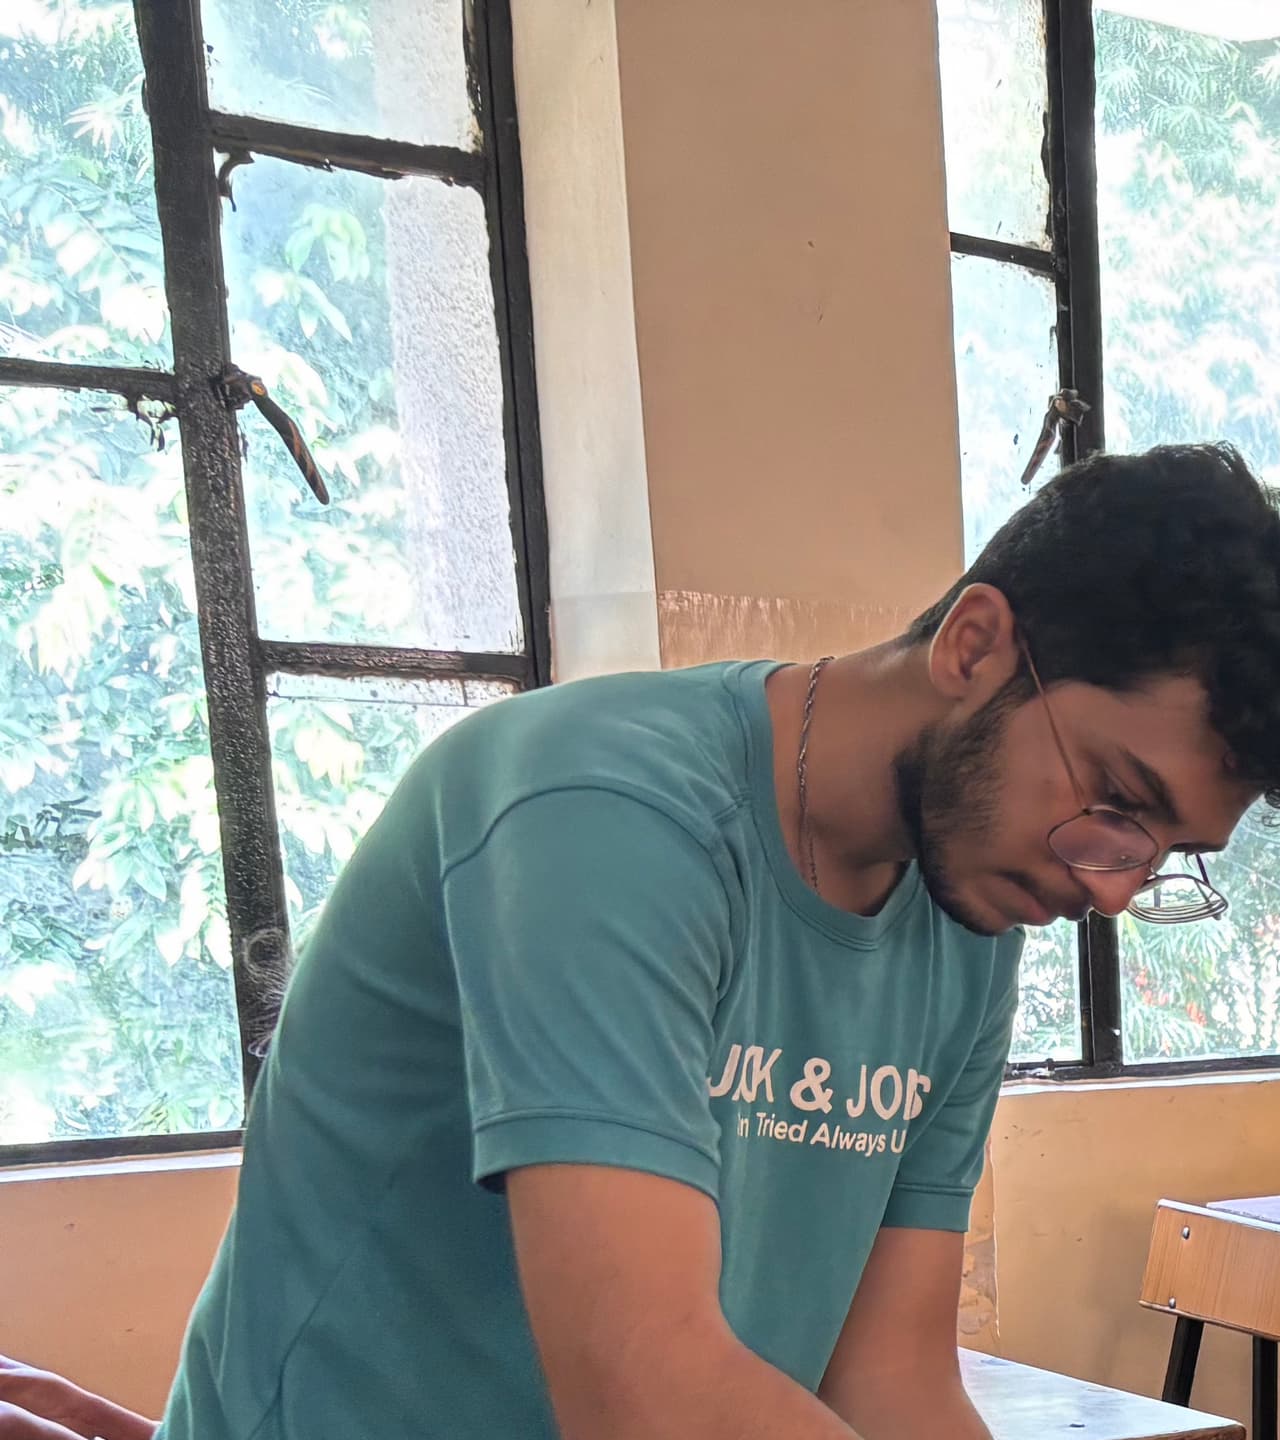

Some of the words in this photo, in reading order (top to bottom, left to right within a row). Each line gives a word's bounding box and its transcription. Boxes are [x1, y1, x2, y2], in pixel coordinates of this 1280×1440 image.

[789, 1057, 834, 1114] &
[755, 1111, 808, 1143] Tried
[810, 1122, 887, 1157] Always
